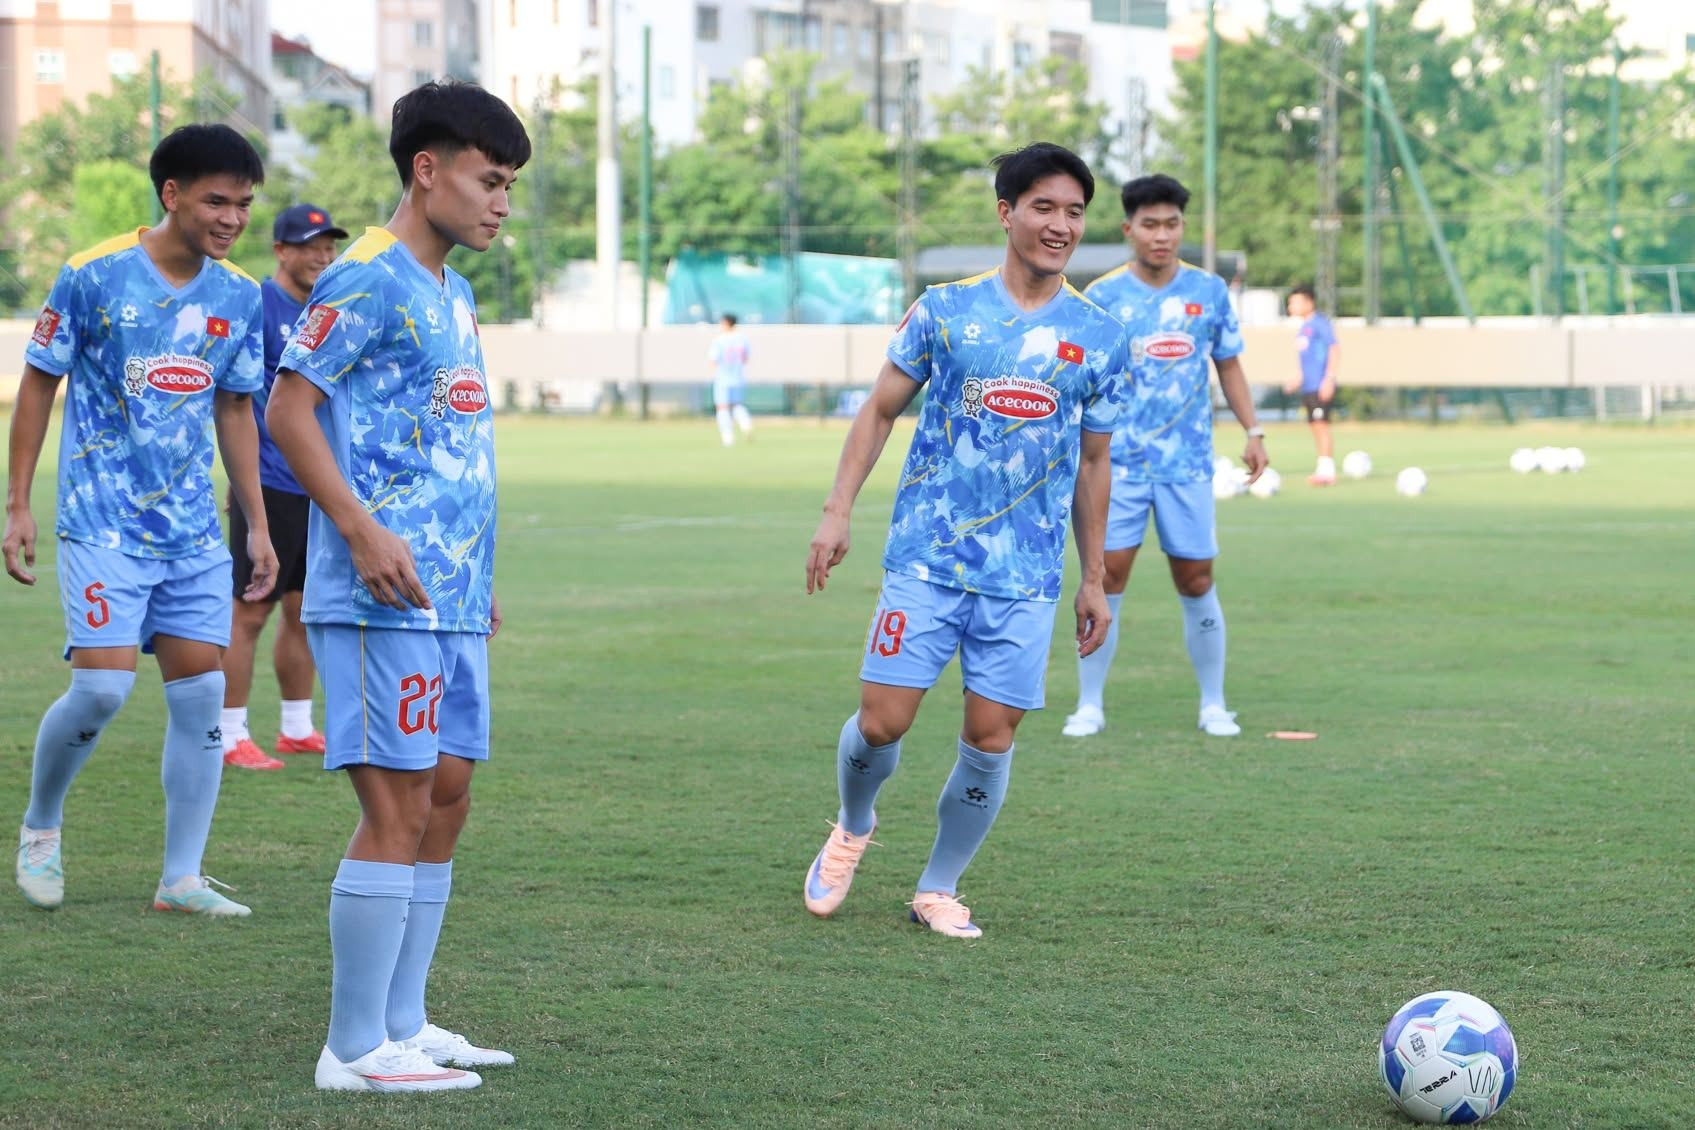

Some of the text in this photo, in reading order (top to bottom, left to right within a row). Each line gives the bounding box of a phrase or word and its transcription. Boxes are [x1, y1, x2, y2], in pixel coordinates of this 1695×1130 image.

[147, 354, 169, 367] Cook
[983, 376, 1059, 399] Cook happiness
[84, 581, 110, 629] 5
[870, 608, 907, 657] 19
[398, 672, 443, 736] 22
[1419, 1070, 1458, 1094] TERRA
[1468, 1065, 1498, 1095] VN
